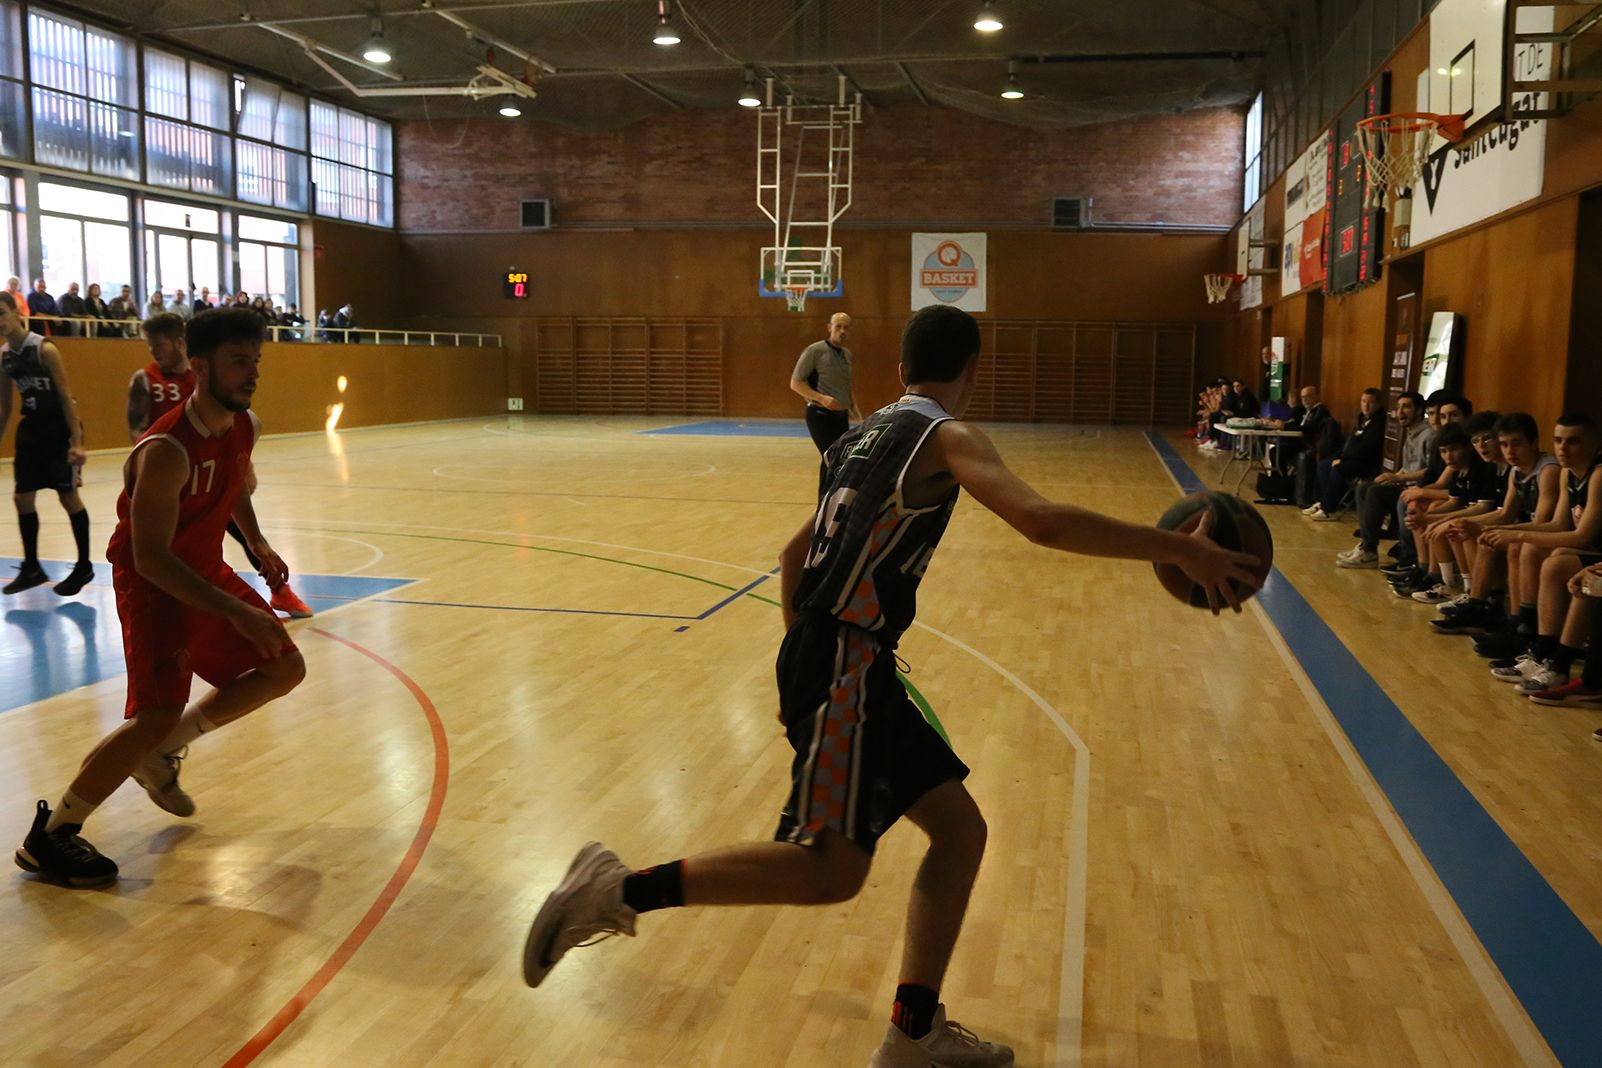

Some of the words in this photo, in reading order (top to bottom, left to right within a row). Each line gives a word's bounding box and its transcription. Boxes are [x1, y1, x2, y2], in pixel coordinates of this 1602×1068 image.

[936, 242, 962, 267] Q
[923, 272, 974, 284] BASKET
[152, 383, 181, 403] 33
[190, 459, 216, 496] 17
